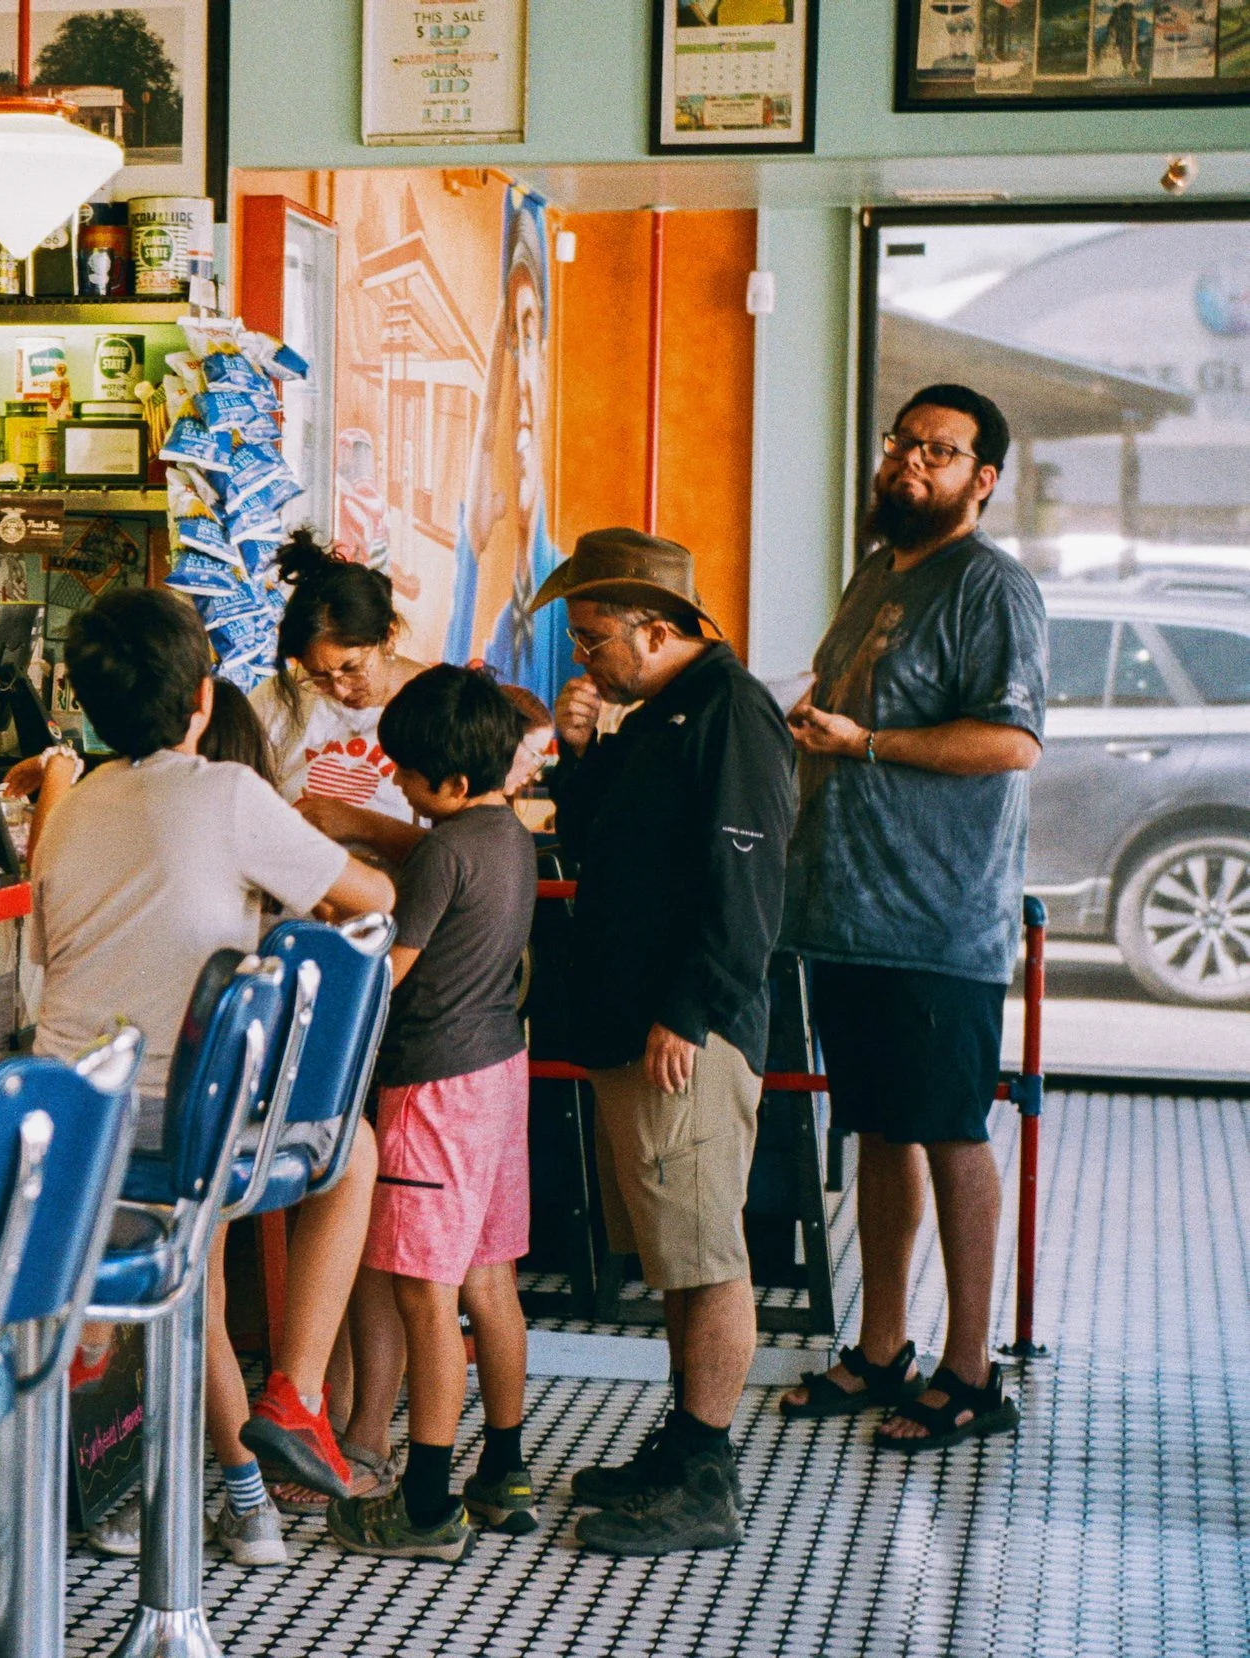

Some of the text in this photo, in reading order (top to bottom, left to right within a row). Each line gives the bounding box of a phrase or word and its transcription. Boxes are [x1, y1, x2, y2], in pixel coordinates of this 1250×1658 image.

[414, 11, 486, 23] THIS SALE
[421, 69, 472, 78] GALLONS
